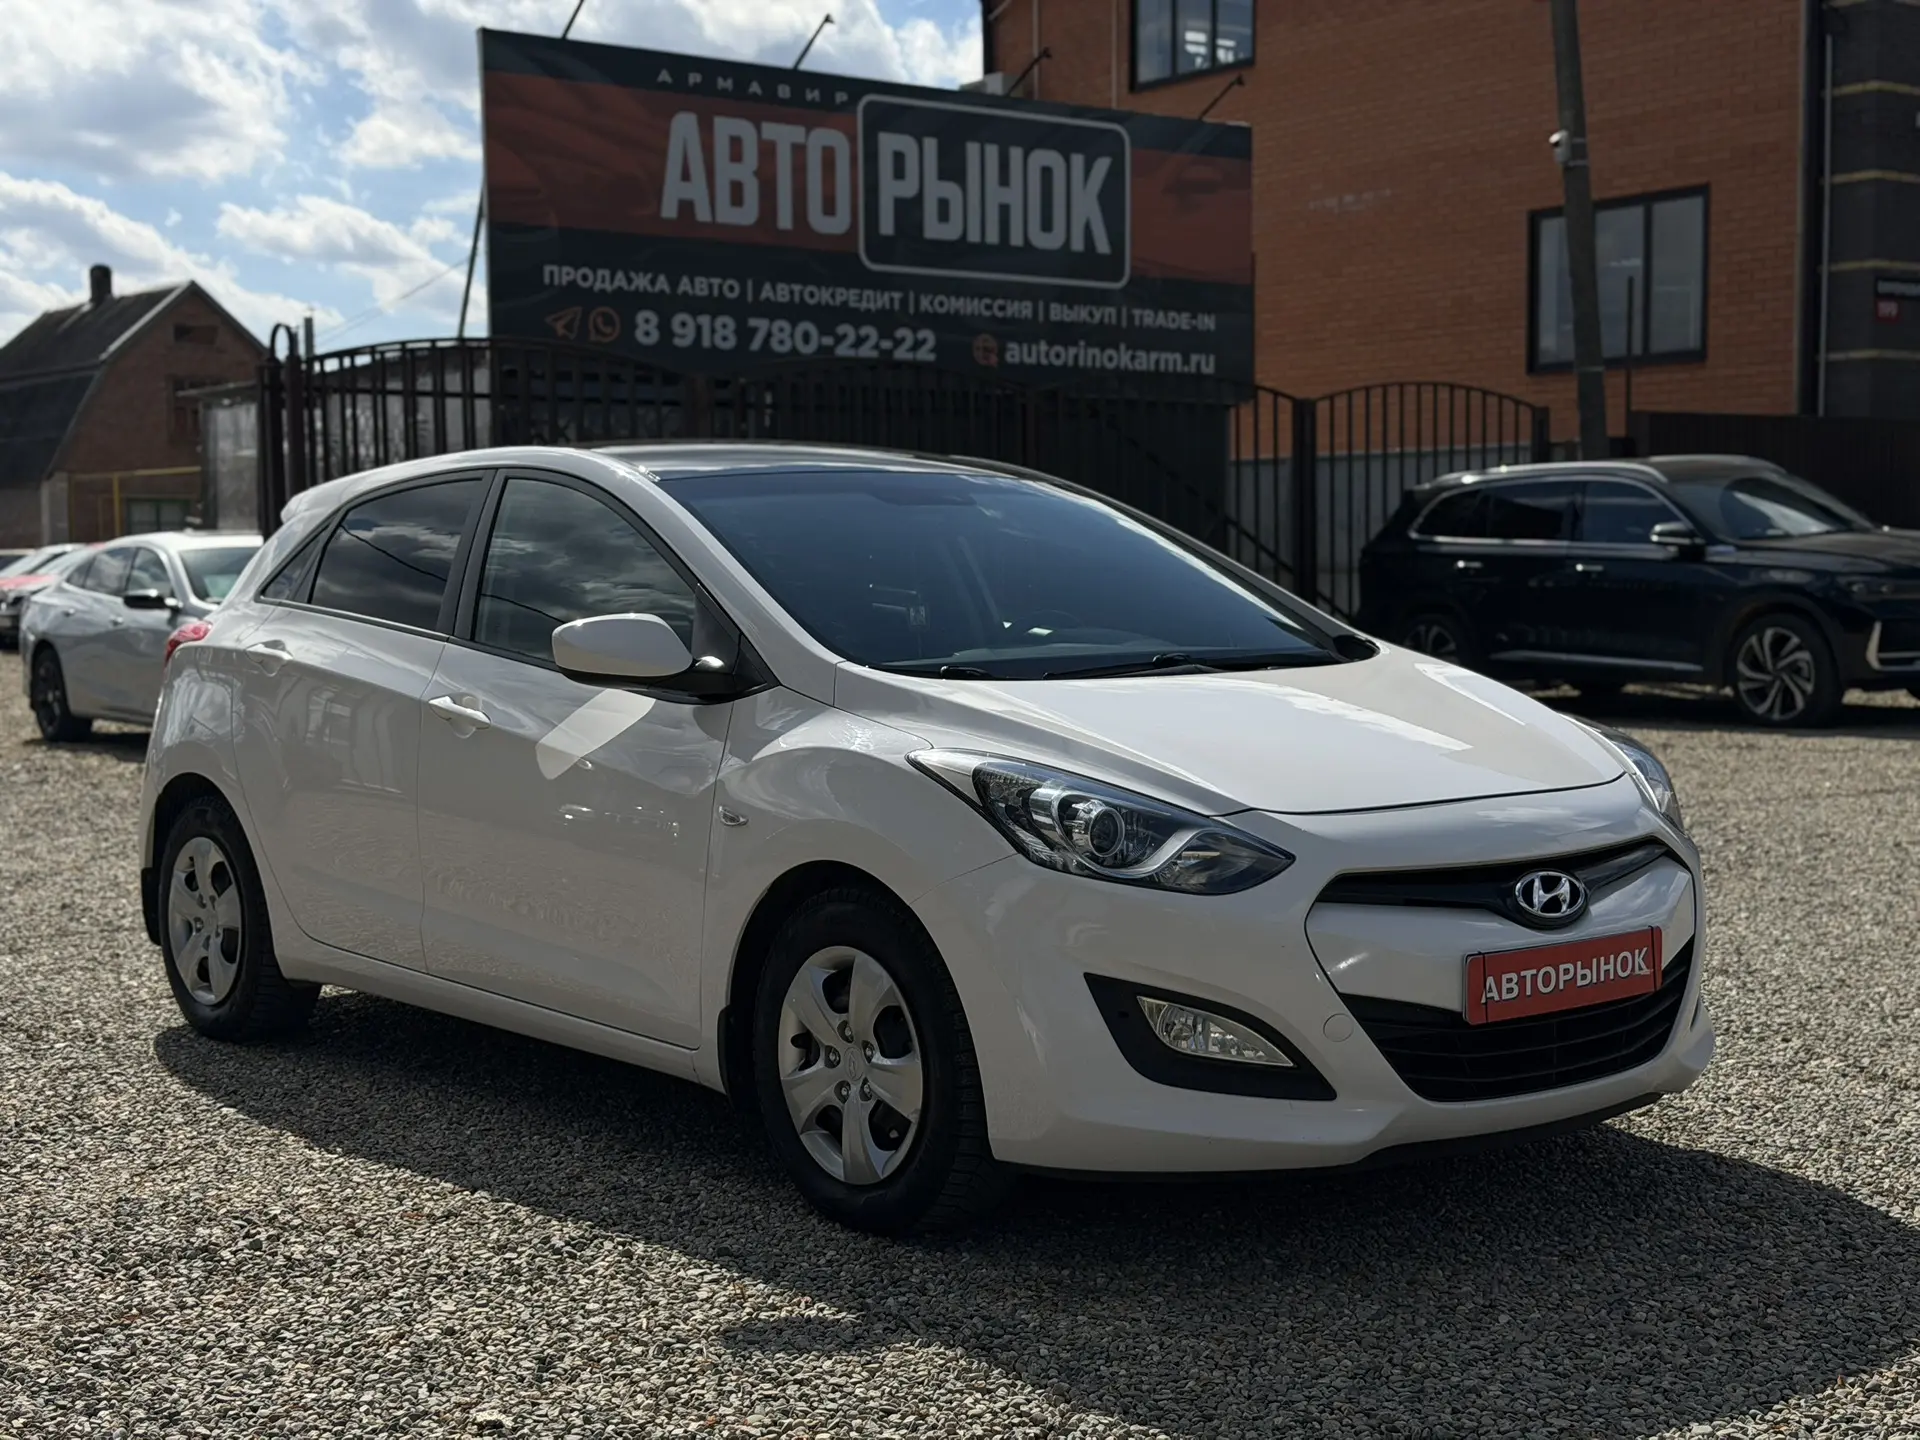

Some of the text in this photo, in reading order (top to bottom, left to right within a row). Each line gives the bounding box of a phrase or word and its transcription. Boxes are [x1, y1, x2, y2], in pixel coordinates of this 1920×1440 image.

[657, 68, 849, 105] АРМАВИР
[660, 111, 1113, 255] АВТО РЫНОК
[543, 264, 1216, 333] ПРОДАЖА АВТО АВТОКРЕДИТ КОМИССИЯ ВЫКУП TRADE-IN
[634, 309, 936, 363] 8 918 780-22-22
[1005, 339, 1216, 375] autorinokarm.ru
[1481, 947, 1650, 1004] АВТОРЫНОК
